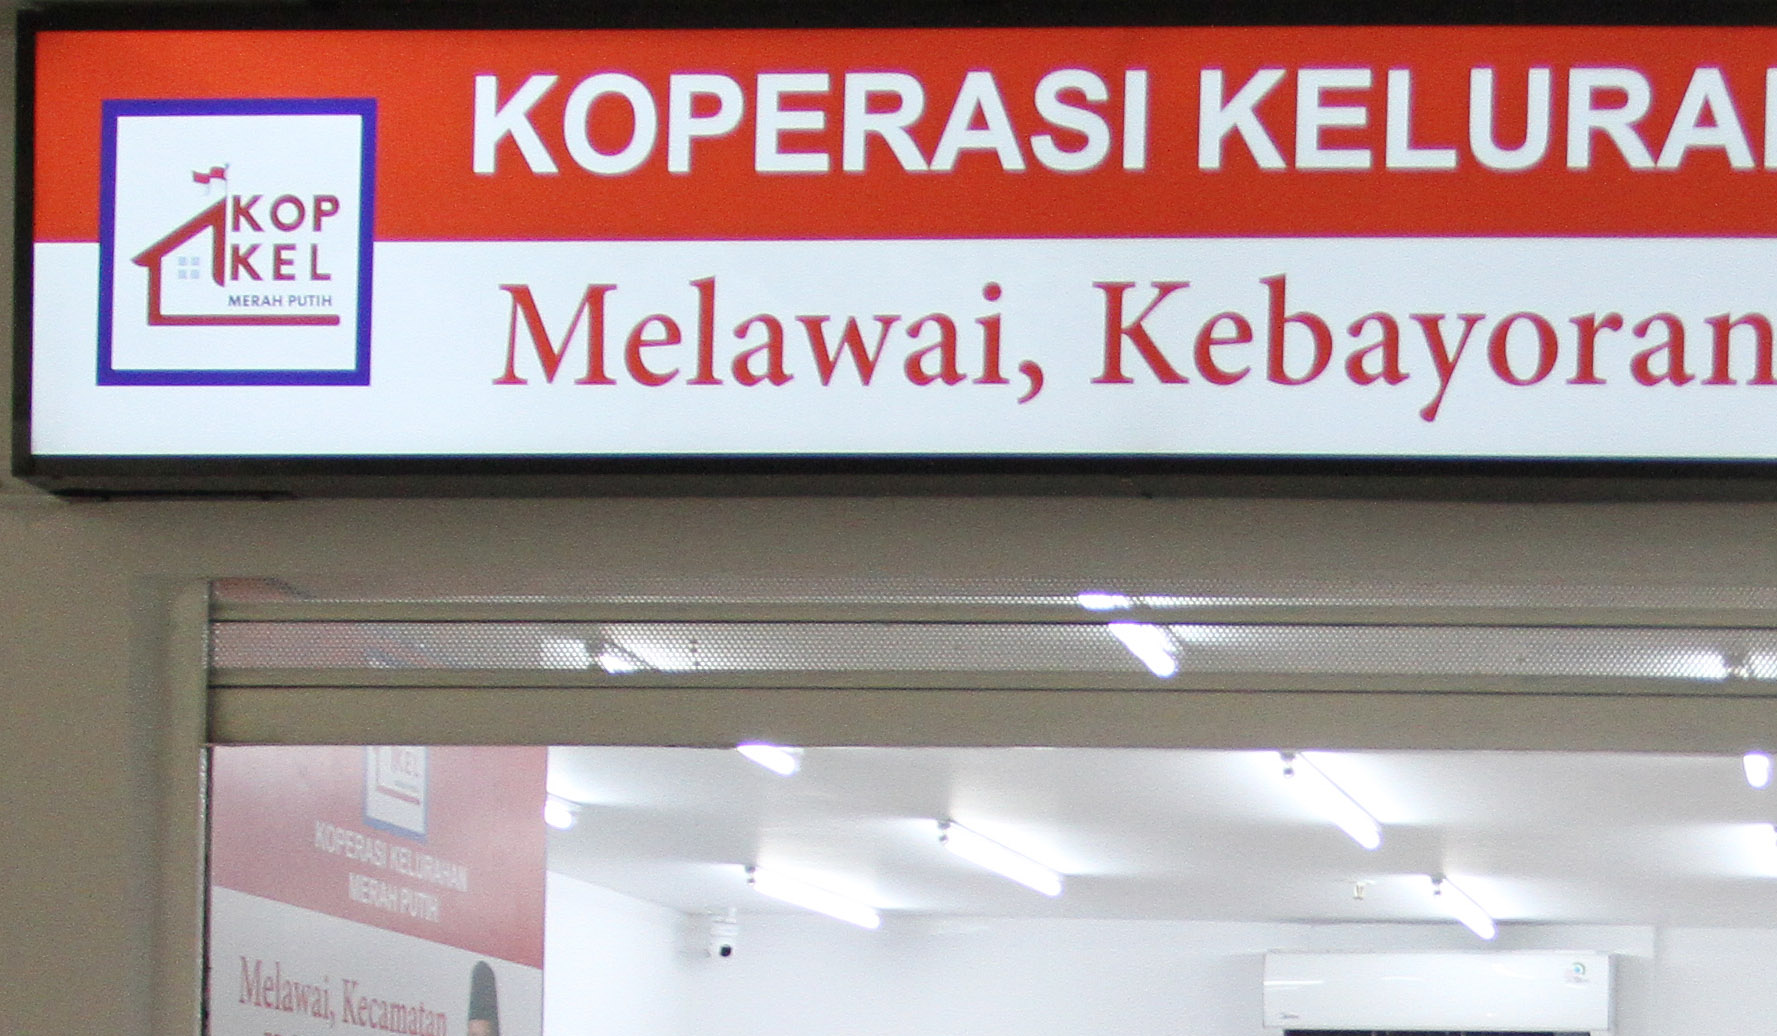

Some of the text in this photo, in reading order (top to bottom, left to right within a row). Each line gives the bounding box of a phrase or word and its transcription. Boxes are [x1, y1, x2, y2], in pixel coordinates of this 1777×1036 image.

[472, 70, 1147, 177] KOPERASI
[231, 195, 340, 233] KOP
[231, 243, 331, 281] KEL
[228, 293, 333, 308] MERAH PUTIH
[491, 273, 1046, 406] Melawai,
[238, 956, 337, 1029] Melawai,
